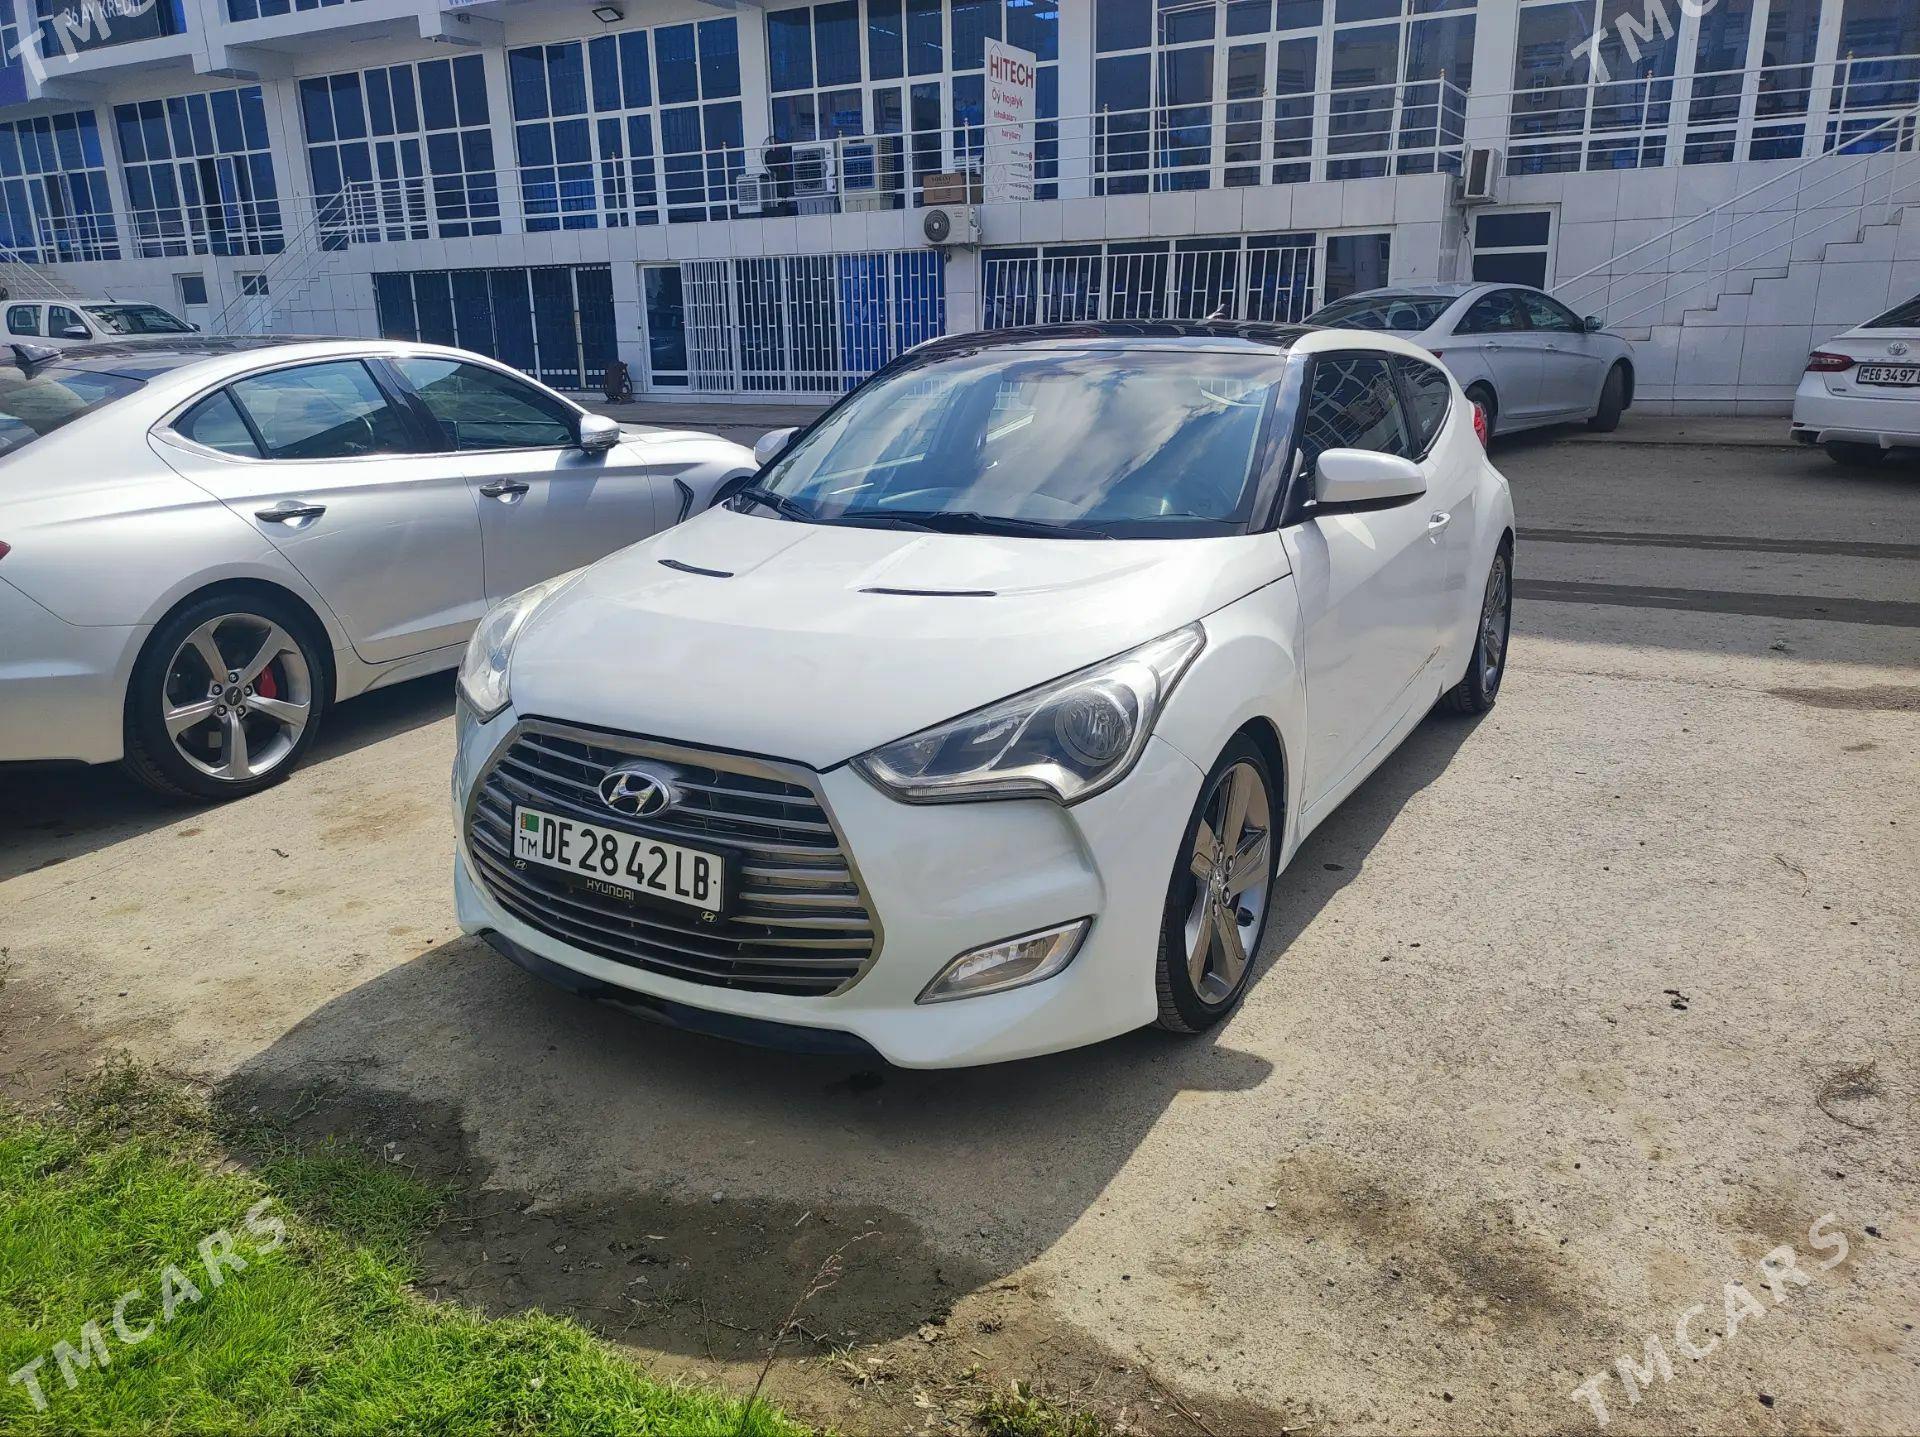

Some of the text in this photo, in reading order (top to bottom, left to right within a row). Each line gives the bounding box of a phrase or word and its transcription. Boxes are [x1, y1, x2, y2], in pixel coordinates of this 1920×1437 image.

[990, 54, 1034, 89] HITECH
[519, 836, 538, 857] TM
[586, 879, 635, 901] HYUNDAI
